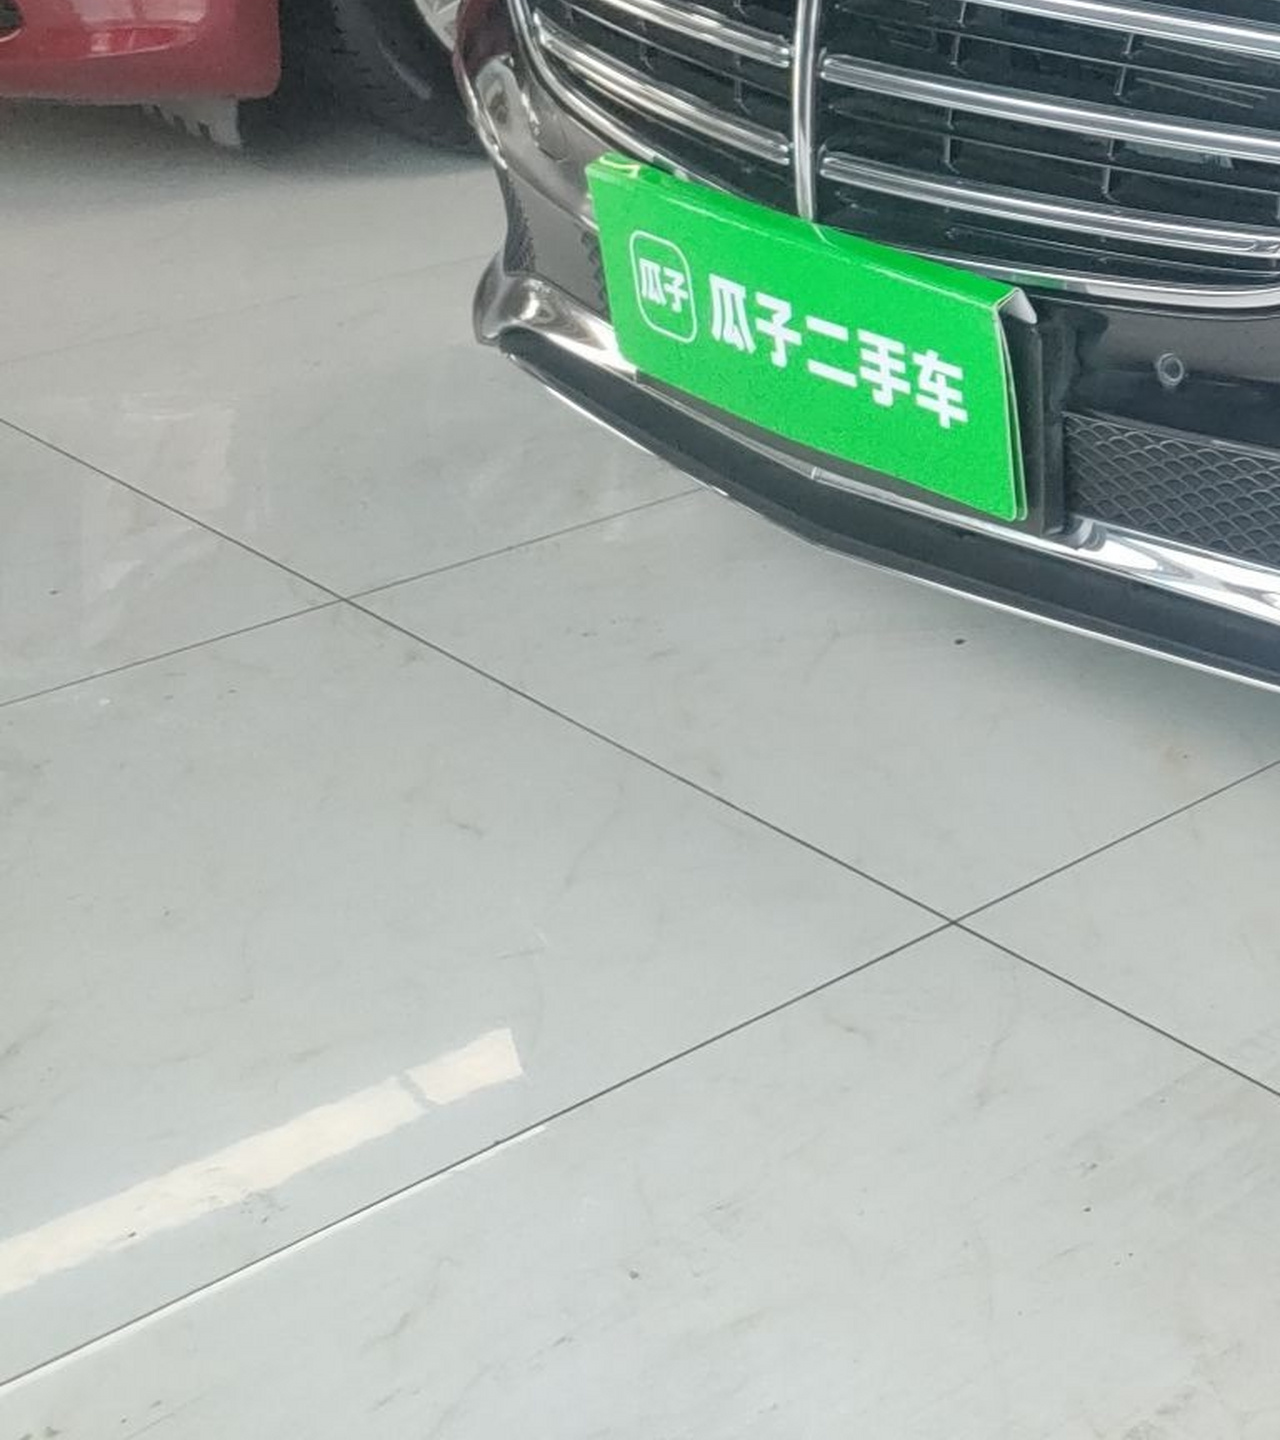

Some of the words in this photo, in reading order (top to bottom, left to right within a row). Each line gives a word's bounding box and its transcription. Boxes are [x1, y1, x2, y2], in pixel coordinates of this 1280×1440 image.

[638, 257, 690, 313] 瓜子
[709, 274, 968, 428] 瓜子二手车
